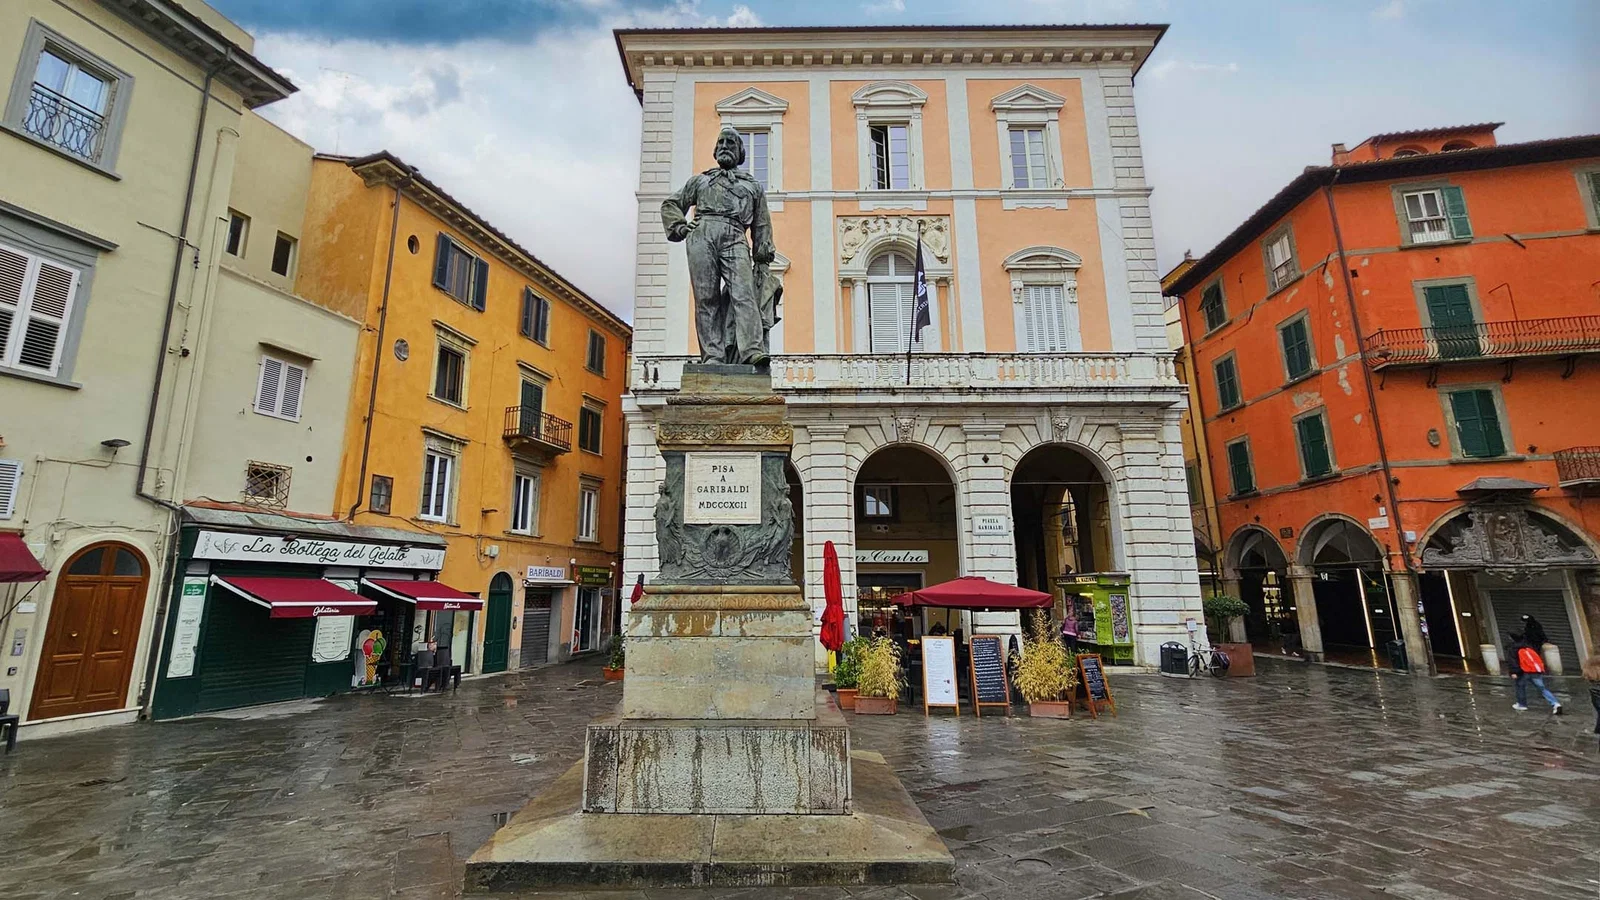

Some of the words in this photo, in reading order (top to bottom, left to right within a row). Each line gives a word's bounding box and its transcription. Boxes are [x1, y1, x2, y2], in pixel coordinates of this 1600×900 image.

[712, 465, 735, 473] PISA
[697, 485, 749, 493] GARIBALDI
[698, 501, 747, 509] MDCCCXCII
[242, 537, 275, 554] La
[280, 540, 342, 562] Bottega
[343, 545, 365, 559] del
[368, 545, 411, 565] Gelato
[870, 550, 926, 562] Centro
[312, 606, 340, 616] Gelateria
